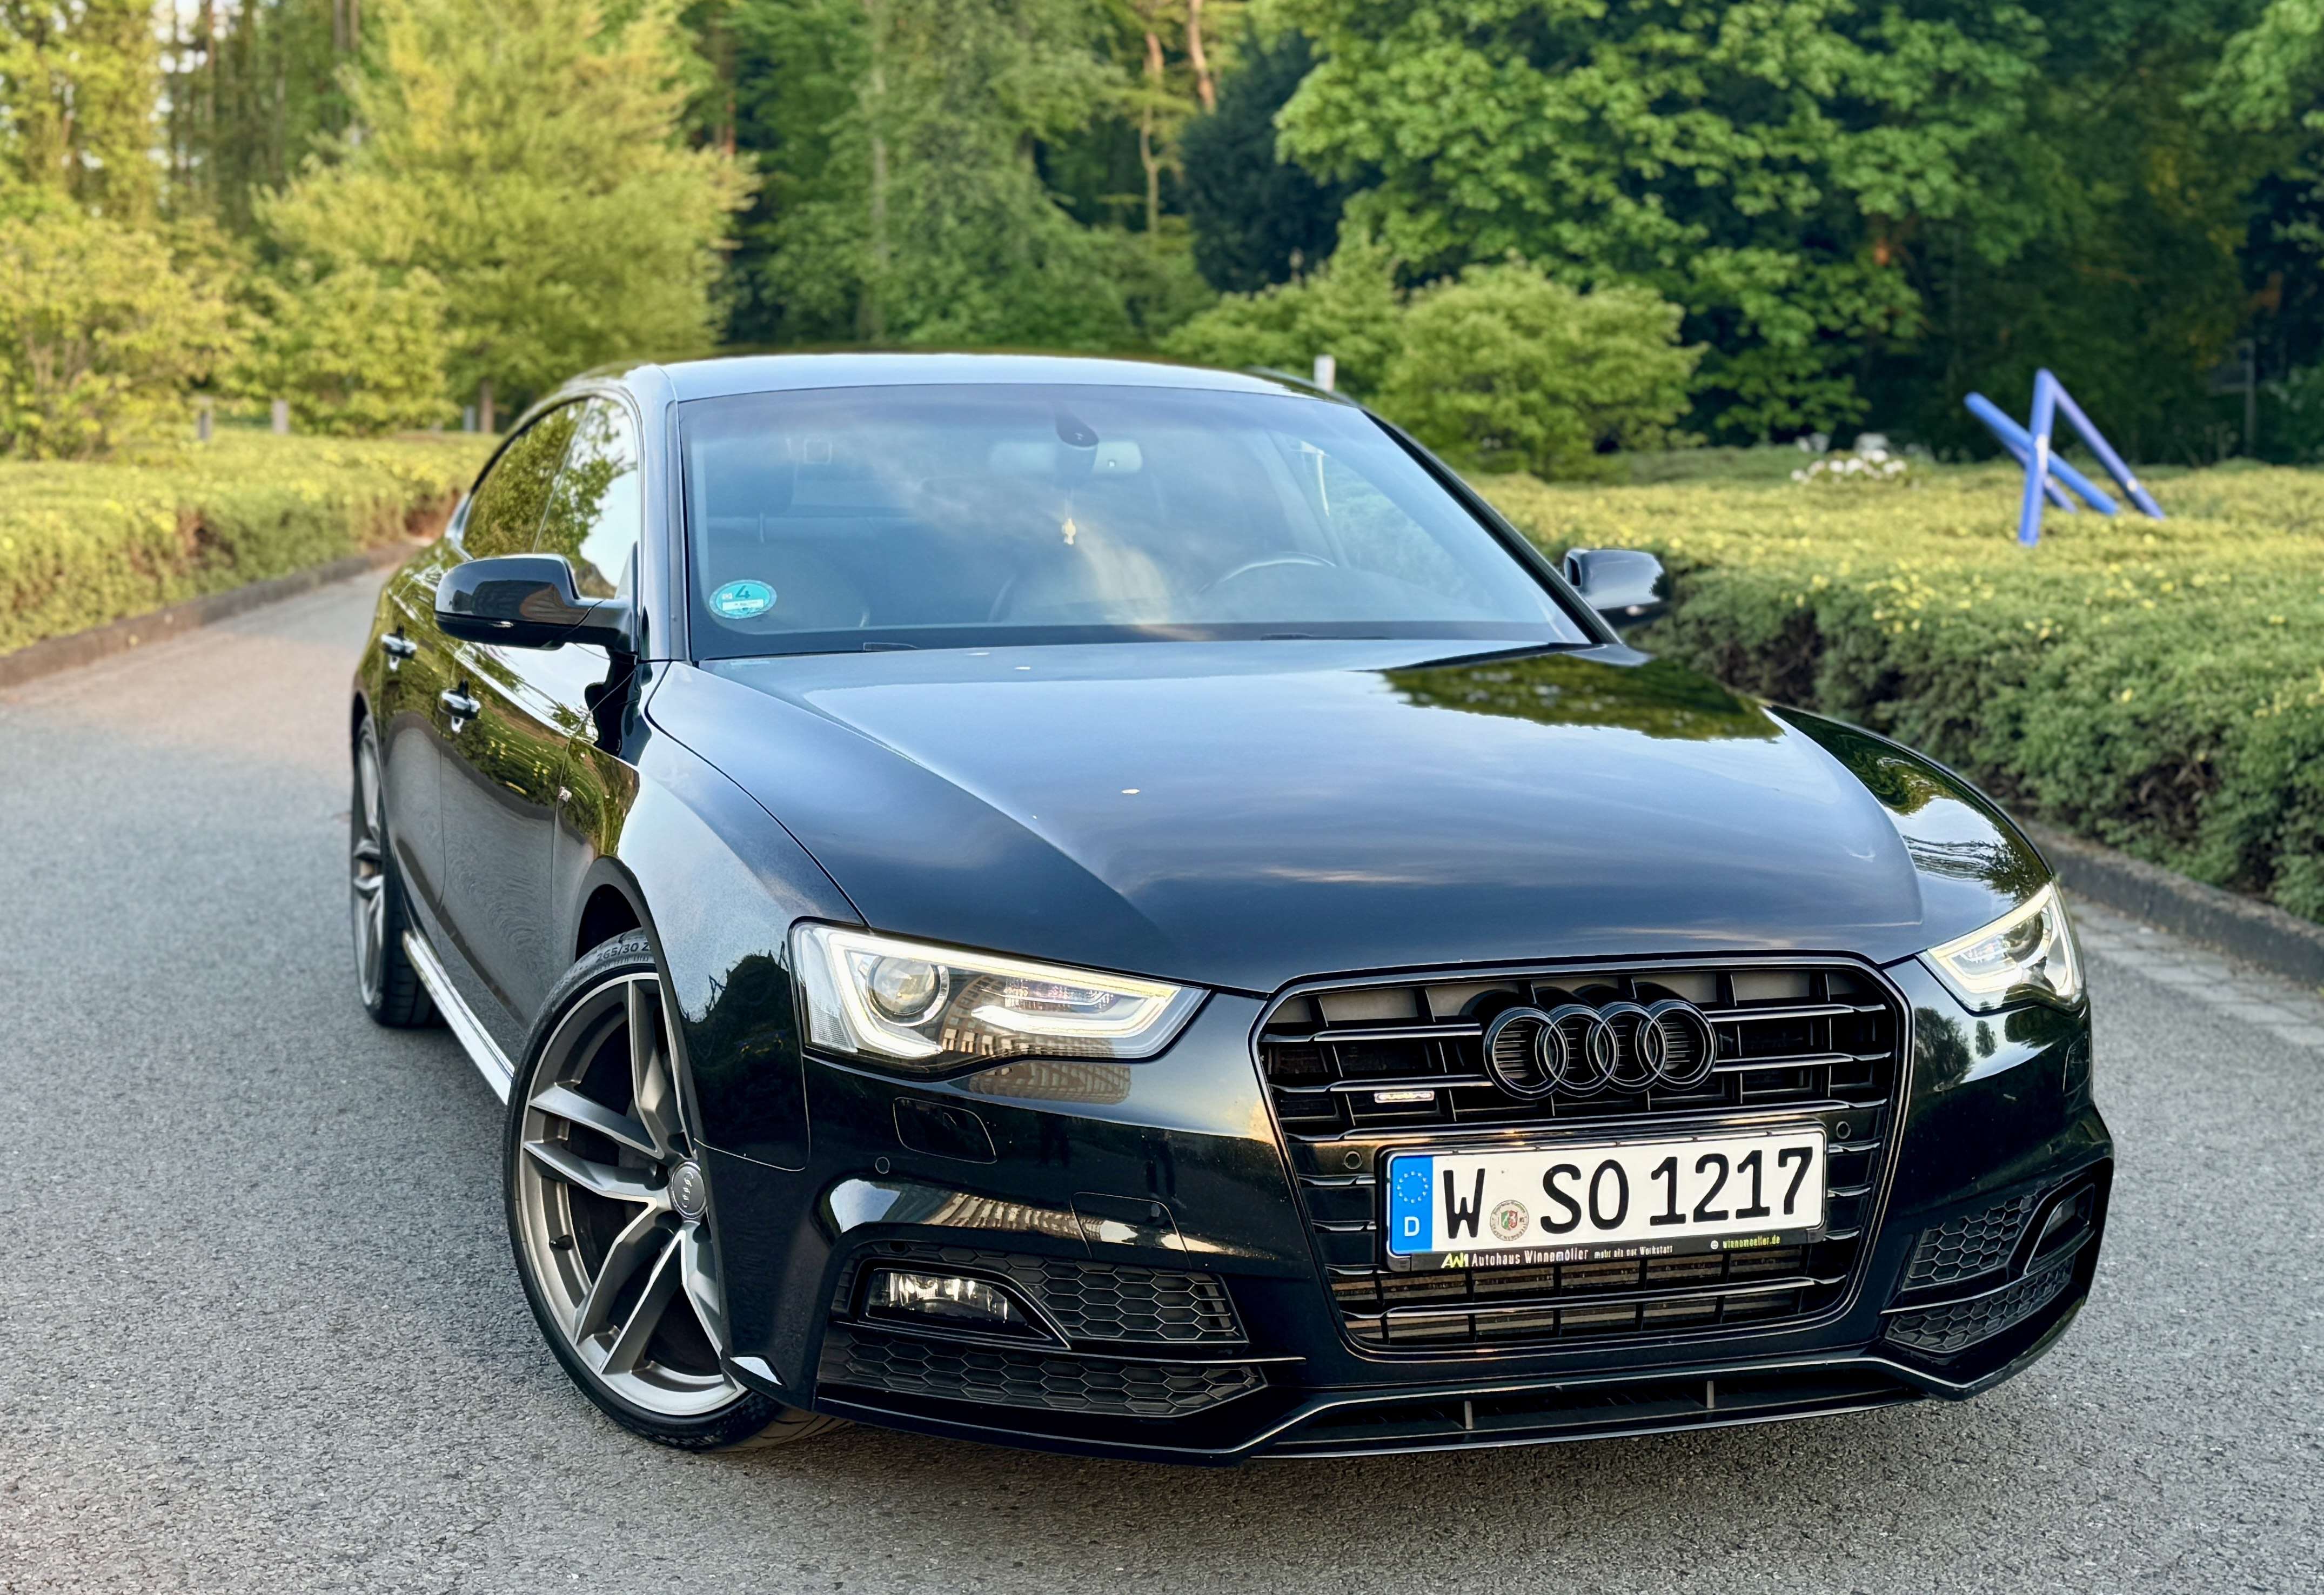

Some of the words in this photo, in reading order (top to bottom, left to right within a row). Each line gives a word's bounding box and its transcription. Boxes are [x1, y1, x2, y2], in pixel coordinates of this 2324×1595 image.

[735, 585, 751, 599] 4
[597, 943, 639, 962] 265/30
[1443, 1168, 1485, 1239] W
[1541, 1159, 1629, 1234] SO
[1650, 1147, 1813, 1226] 1217
[1404, 1216, 1420, 1237] D
[1471, 1253, 1521, 1266] Autohaus
[1524, 1248, 1589, 1264] Winnemöller
